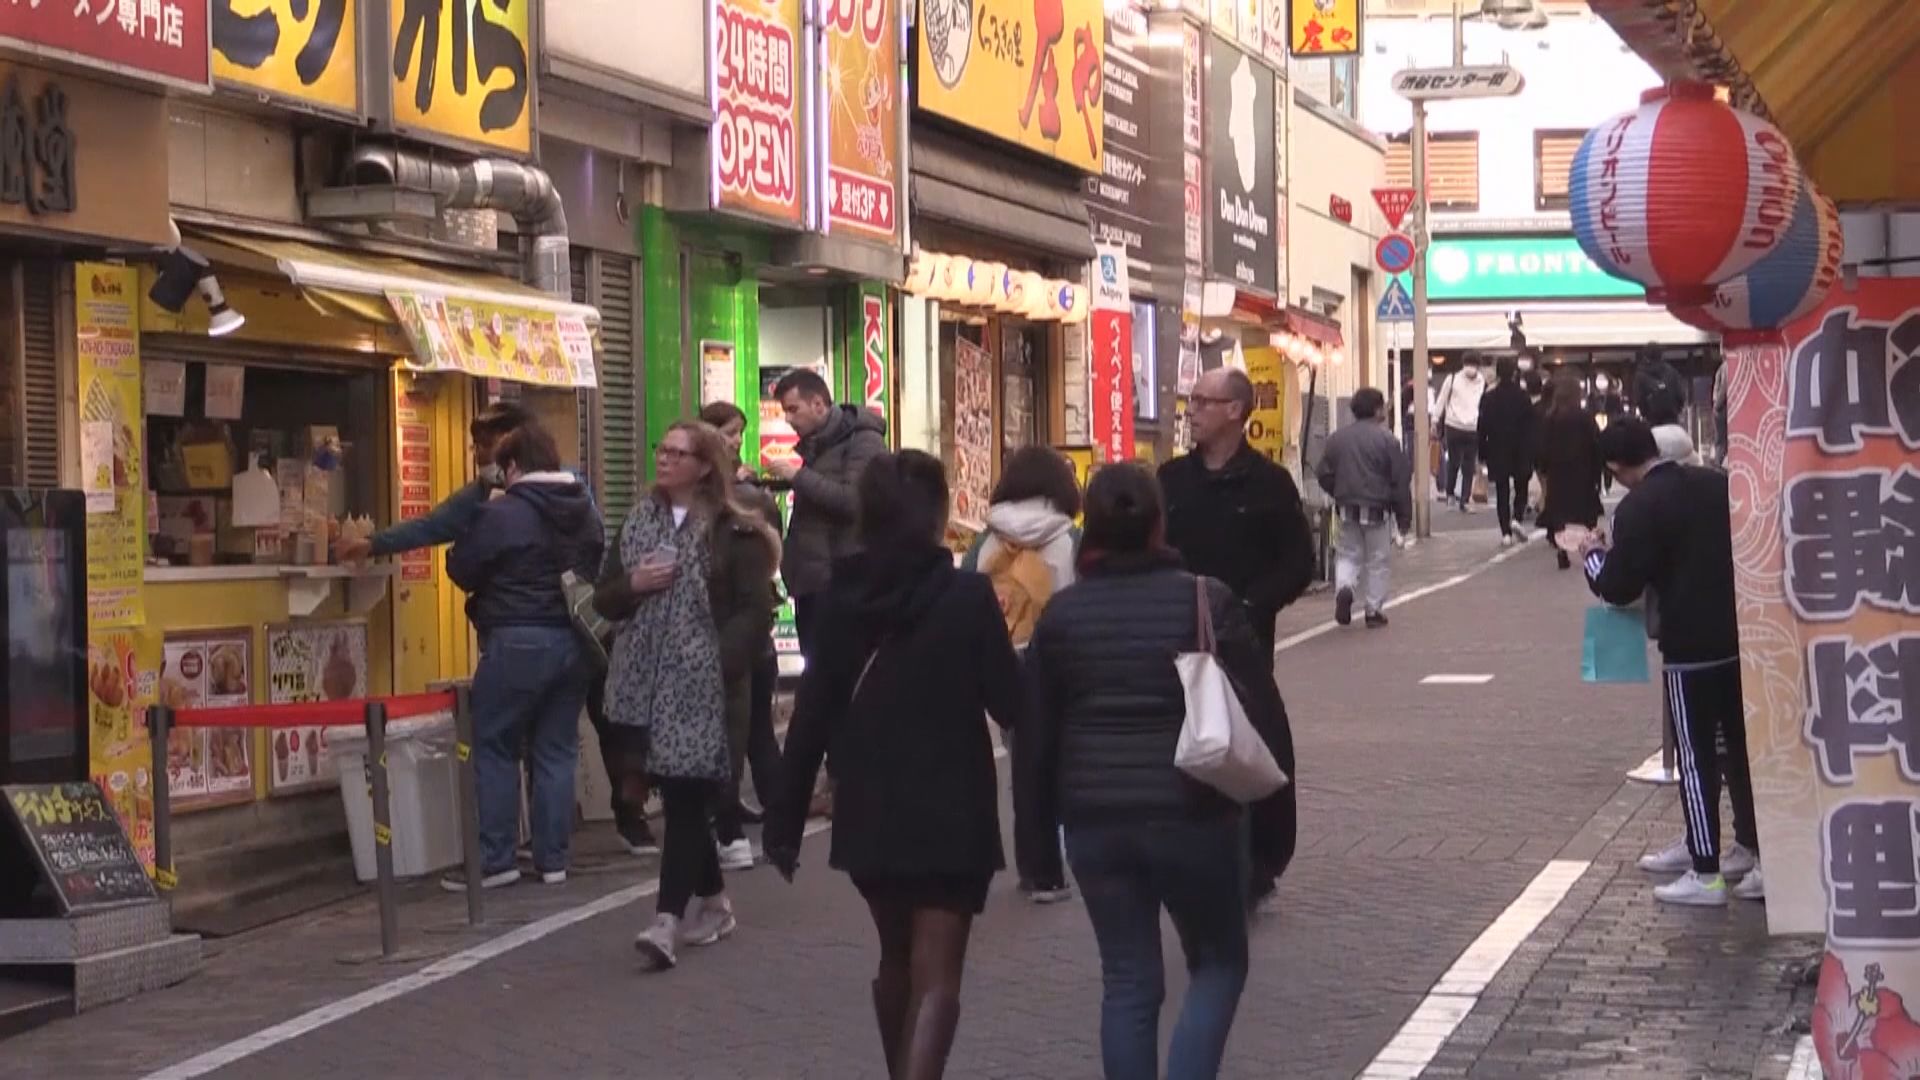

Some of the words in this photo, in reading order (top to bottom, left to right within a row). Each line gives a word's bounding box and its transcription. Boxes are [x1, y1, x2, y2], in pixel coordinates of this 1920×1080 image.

[717, 16, 789, 98] 24時間
[718, 110, 790, 190] OPEN
[1601, 113, 1637, 265] オリオンビール
[1742, 131, 1797, 249] Orion
[841, 181, 876, 220] 受付3F
